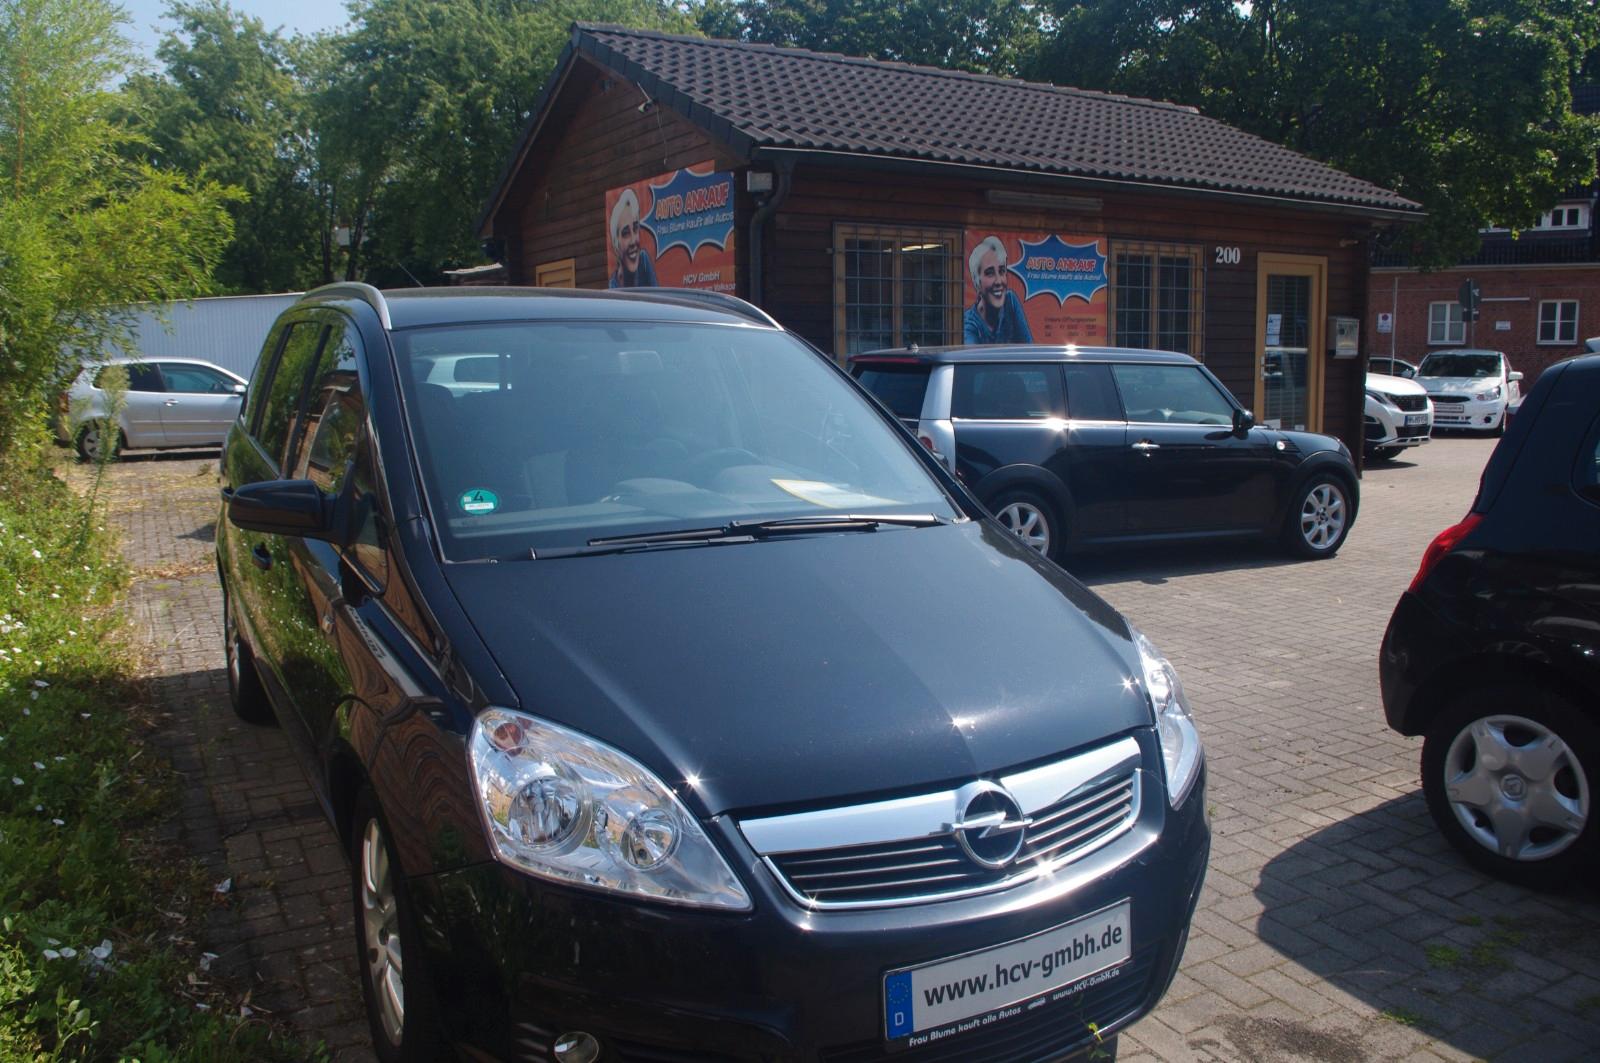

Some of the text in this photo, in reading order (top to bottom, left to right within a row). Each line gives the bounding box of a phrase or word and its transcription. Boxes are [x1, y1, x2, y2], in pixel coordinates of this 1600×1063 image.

[655, 182, 730, 220] AUTO ANKAUF
[1216, 247, 1240, 264] 200
[1026, 257, 1097, 272] AUTO ANKAUF
[683, 271, 720, 285] HCV GmbH
[473, 491, 484, 502] 4
[924, 924, 1122, 1007] www.hcv-gmbh.de
[909, 967, 1120, 1047] Frau Blume kauft alle Autos www.HCV-GmbH.de
[894, 1012, 904, 1026] D
